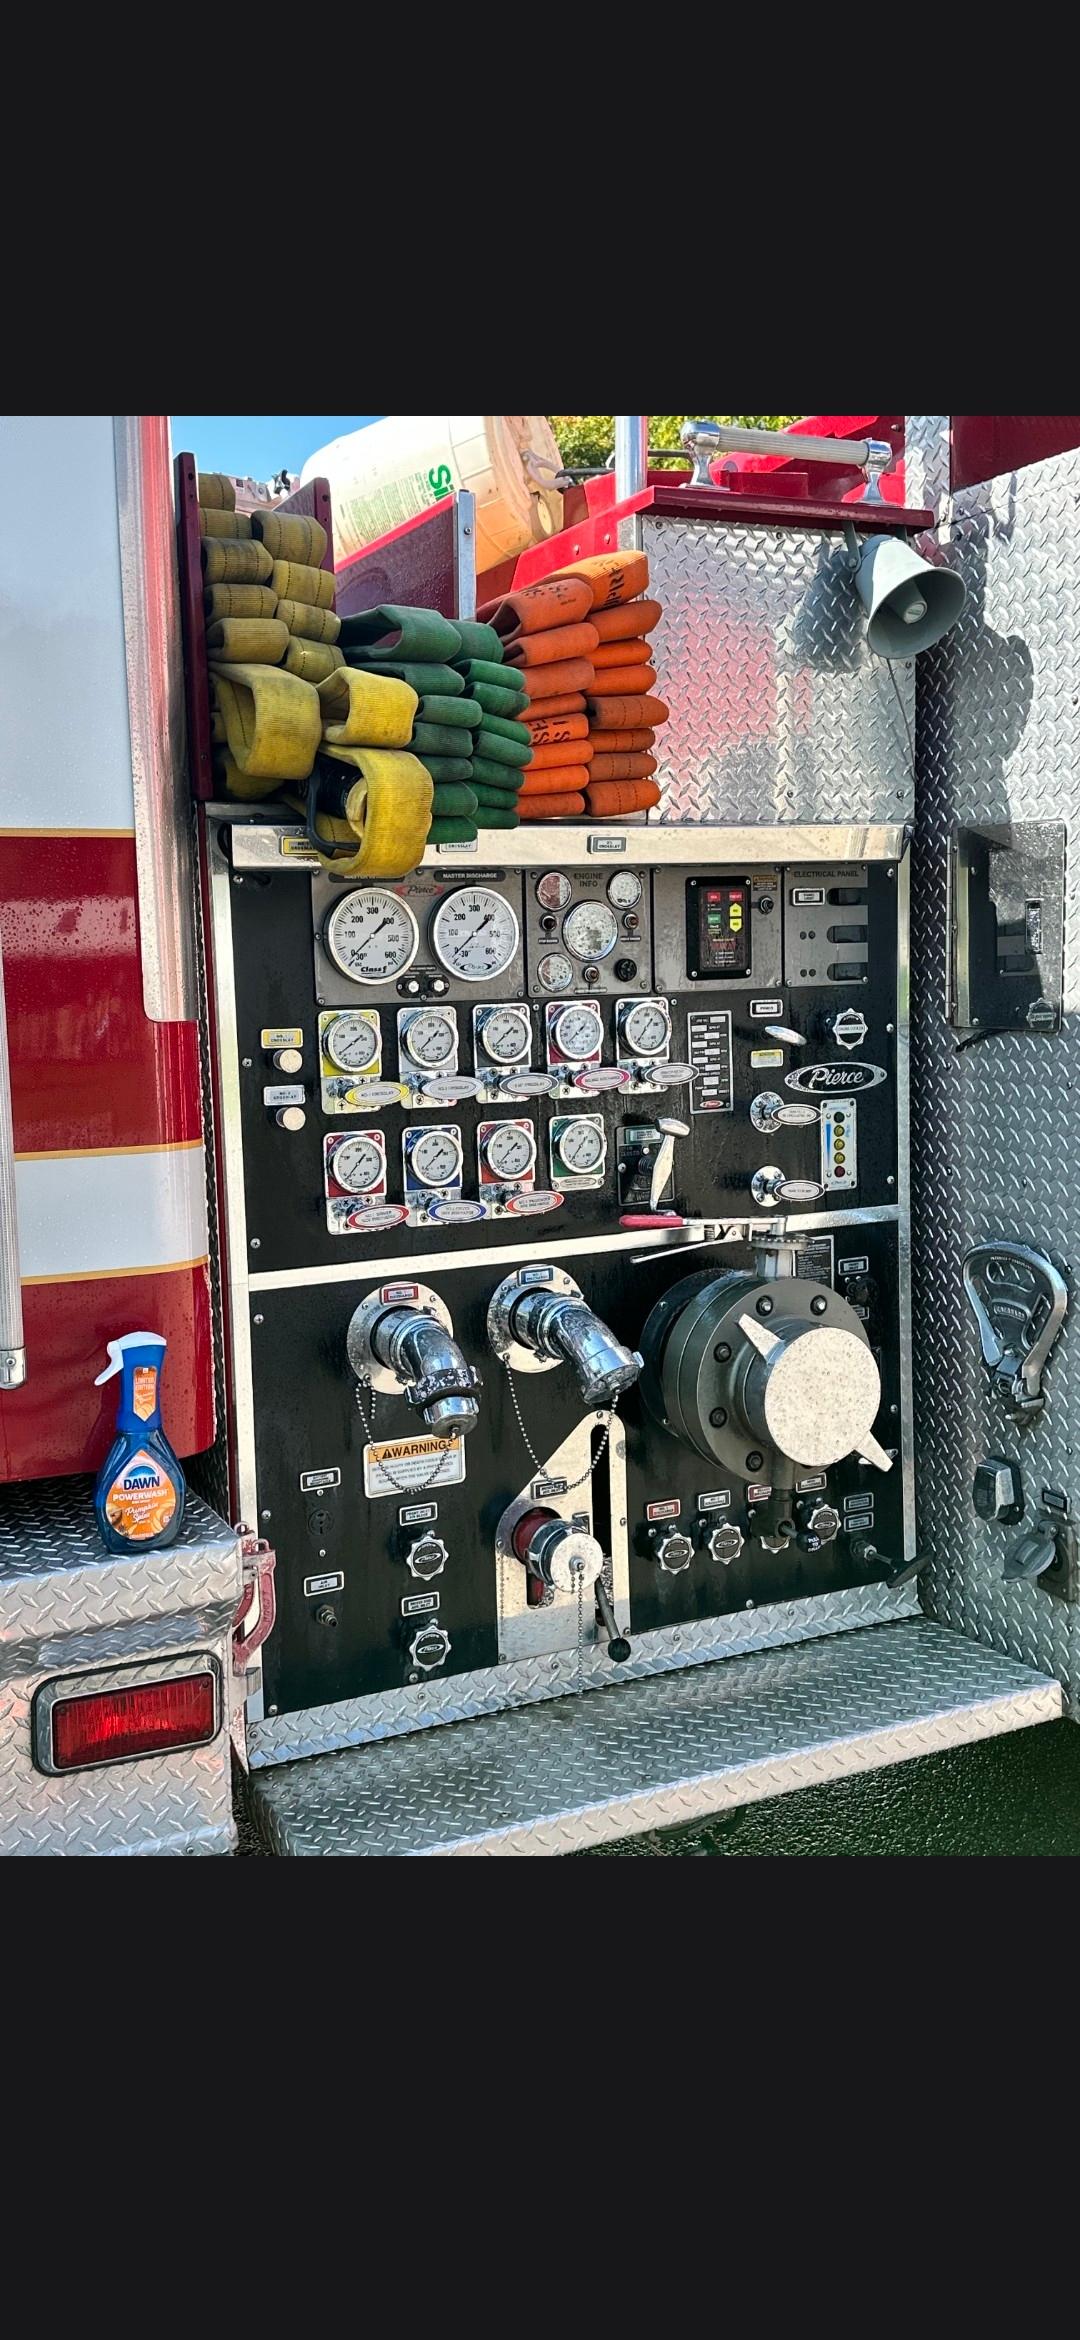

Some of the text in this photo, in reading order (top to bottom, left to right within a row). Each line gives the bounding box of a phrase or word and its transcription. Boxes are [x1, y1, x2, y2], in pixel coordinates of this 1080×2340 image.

[469, 904, 480, 912] 300
[344, 930, 356, 938] 100
[808, 1067, 864, 1088] Pierce
[392, 1440, 447, 1457] WARNING
[124, 1476, 160, 1490] DAWN
[112, 1489, 167, 1501] POWERWASH
[125, 1503, 159, 1516] Pumpkin
